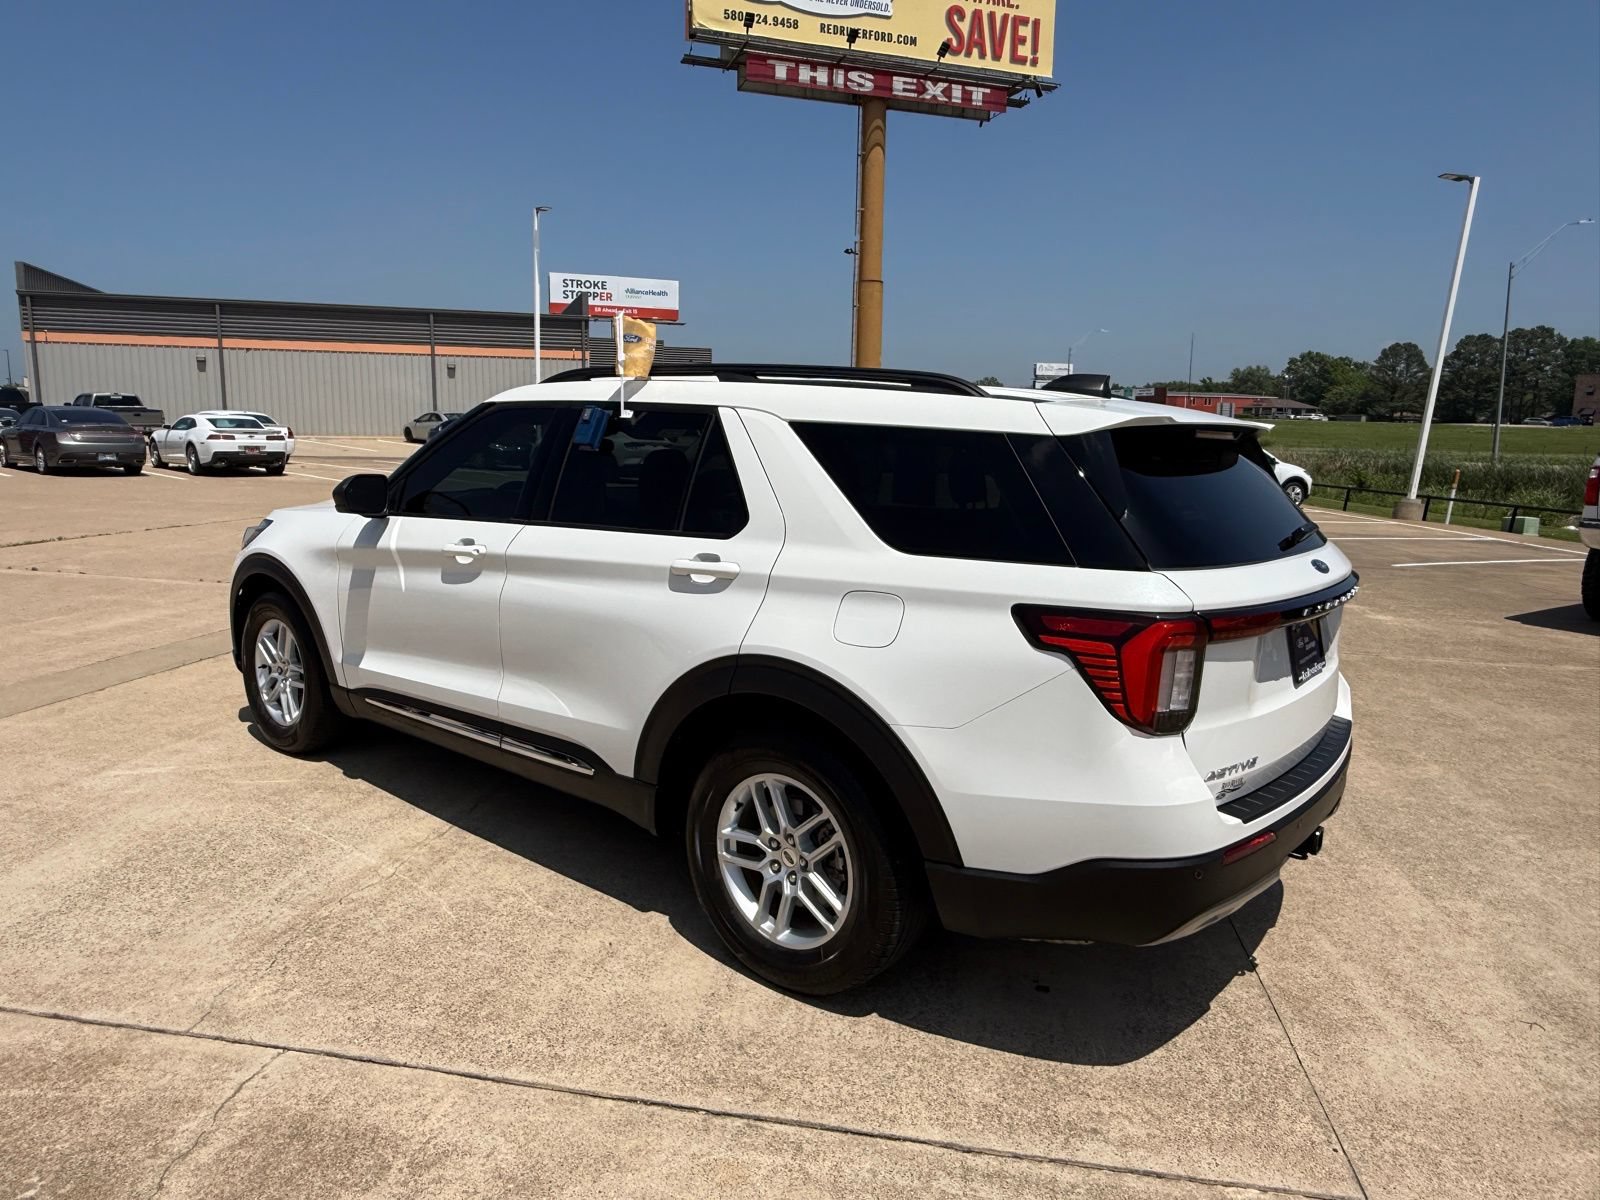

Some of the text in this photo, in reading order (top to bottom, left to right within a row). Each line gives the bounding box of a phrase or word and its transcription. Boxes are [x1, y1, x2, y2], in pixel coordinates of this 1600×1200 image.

[850, 0, 890, 13] UNDERSOLD.
[723, 9, 799, 29] 58024.9458
[820, 22, 917, 47] REDRIERFORD.COM
[945, 4, 1041, 67] SAVE!
[766, 59, 991, 106] THIS EXIT
[562, 278, 607, 290] STROKE
